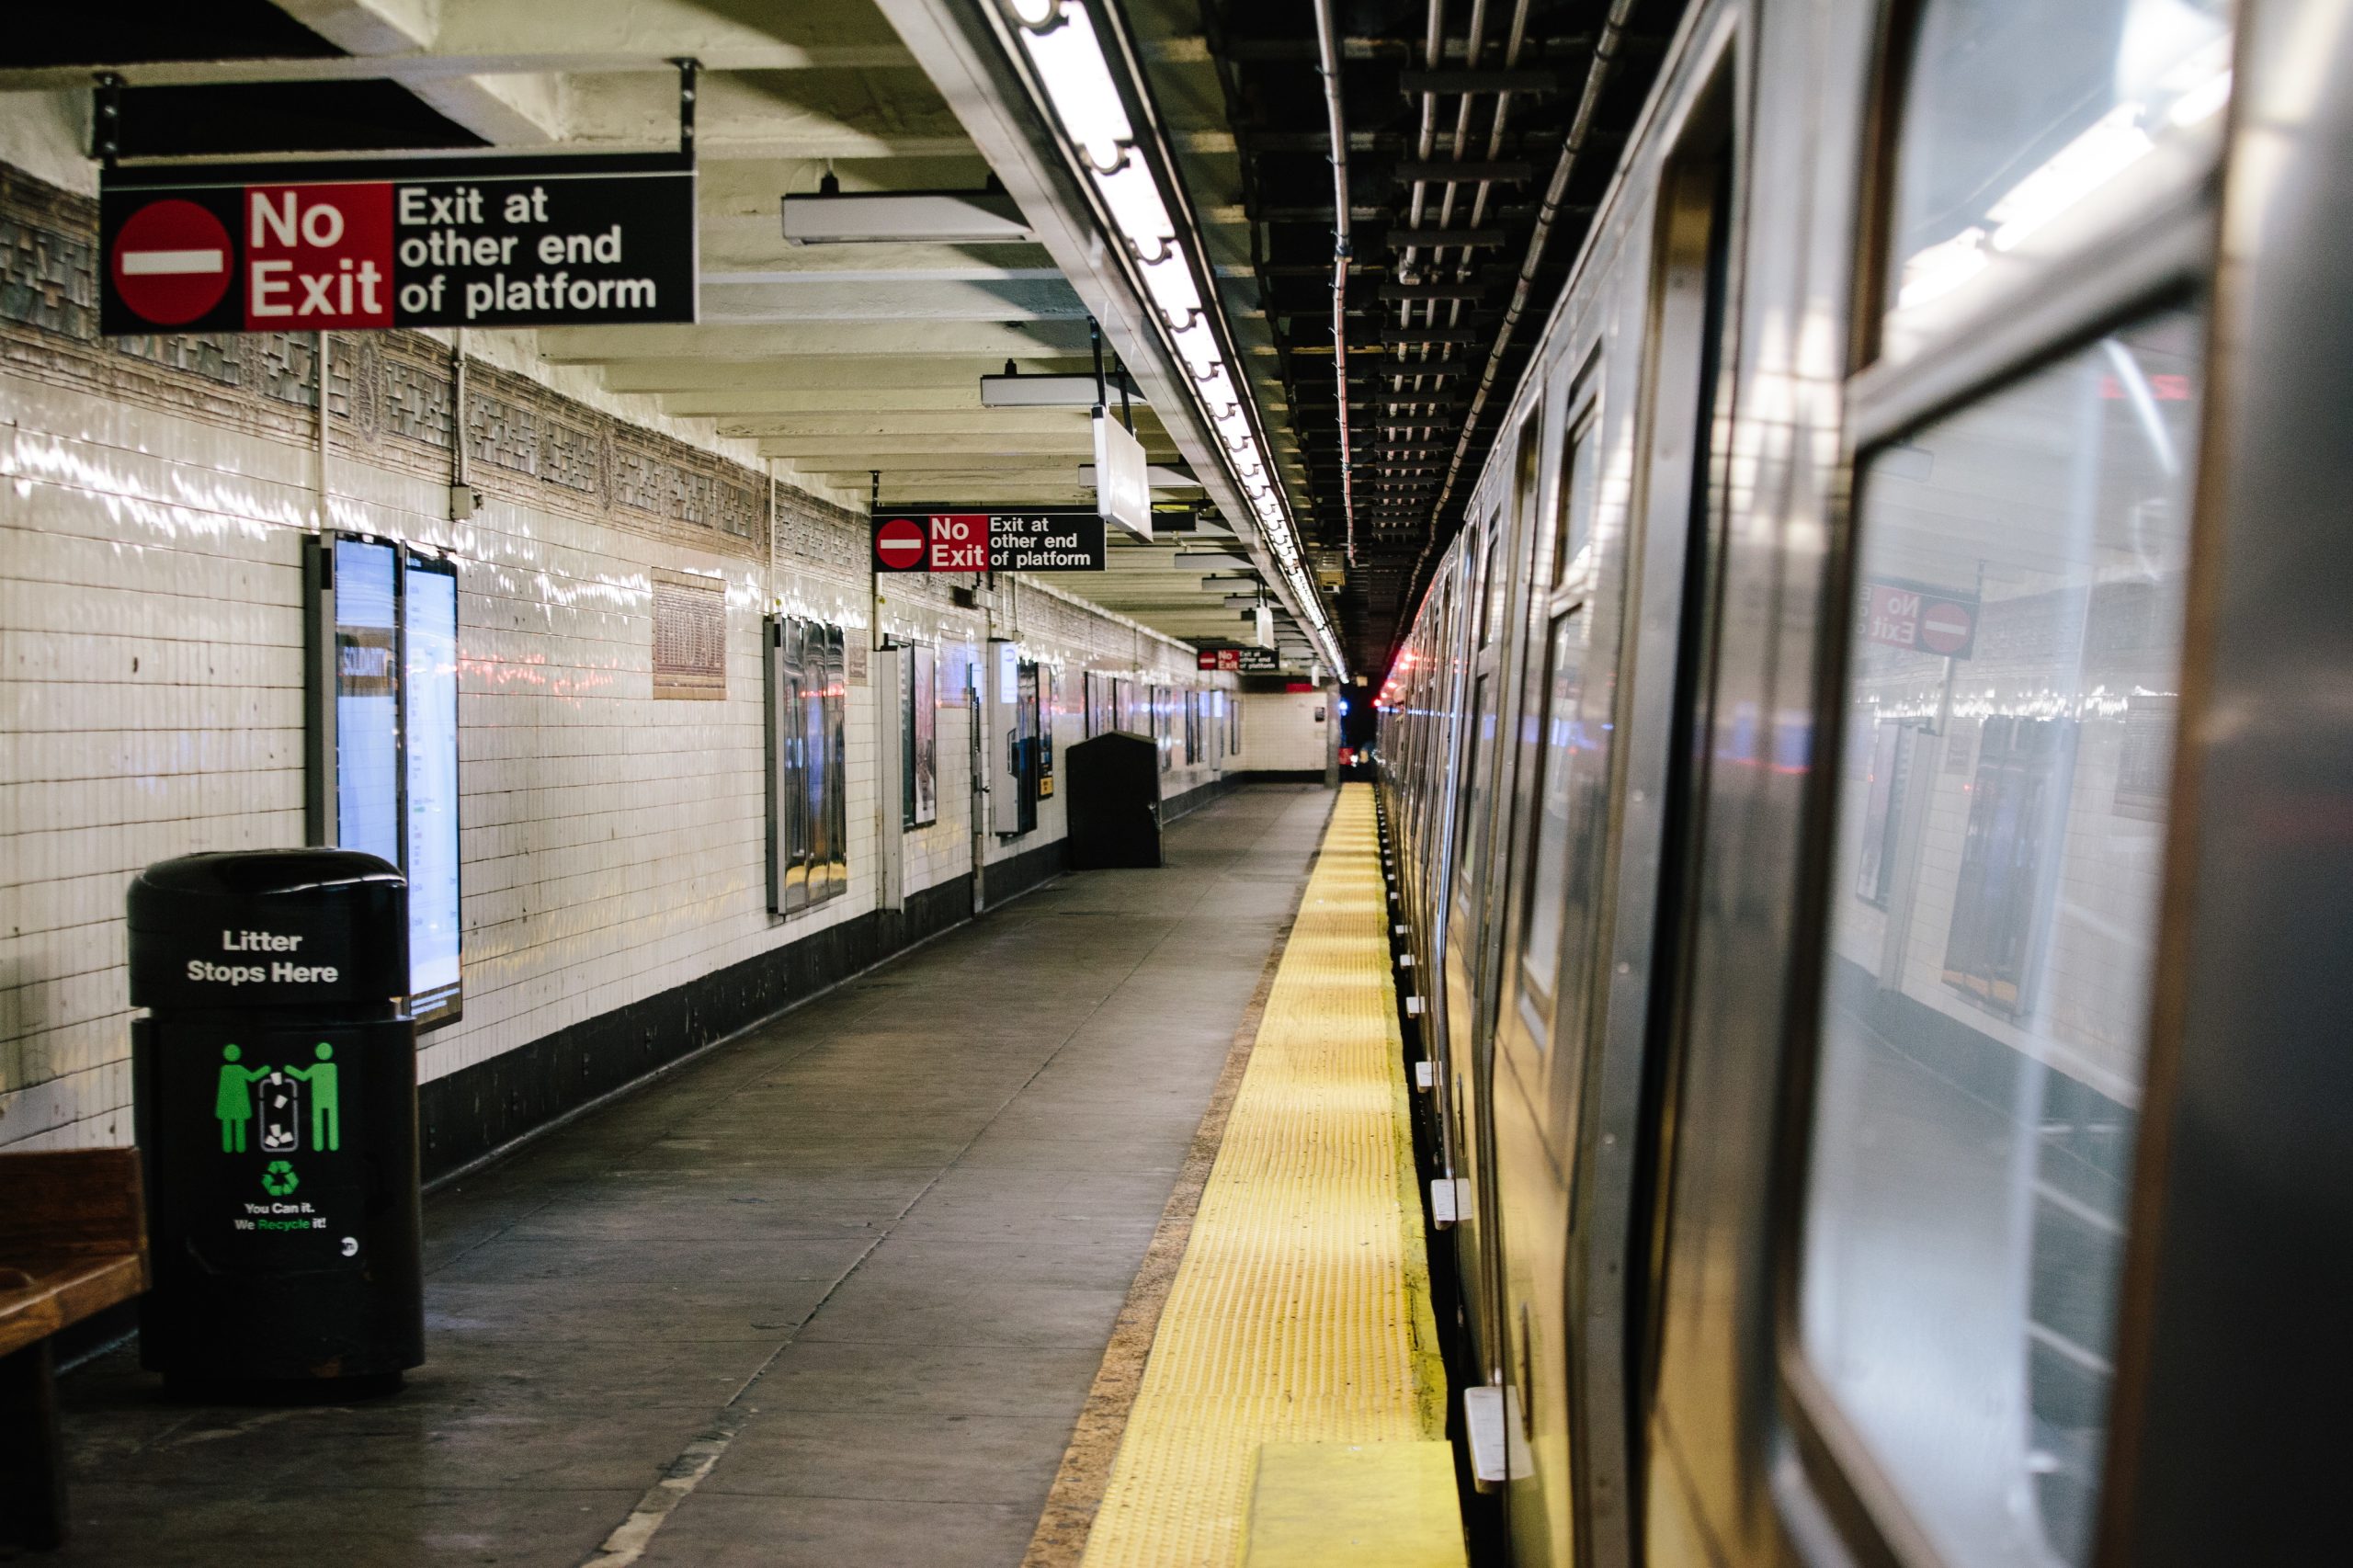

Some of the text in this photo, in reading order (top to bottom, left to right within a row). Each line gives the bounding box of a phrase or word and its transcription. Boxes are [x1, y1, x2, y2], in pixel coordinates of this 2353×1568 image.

[398, 186, 549, 226] Exit at
[251, 190, 345, 248] No
[399, 225, 622, 267] other end
[251, 257, 382, 317] Exit
[399, 271, 657, 320] of platform
[931, 517, 970, 540] No
[990, 517, 1050, 532] Exit at
[990, 532, 1078, 549] other end
[931, 543, 984, 567] Exit
[990, 550, 1091, 569] of platform
[1218, 651, 1233, 660] No
[1218, 660, 1238, 669] Exit
[222, 929, 303, 952] Litter
[187, 960, 339, 986] Stops Here
[244, 1202, 315, 1214] You Can it.
[234, 1218, 326, 1232] We Recycle it!
